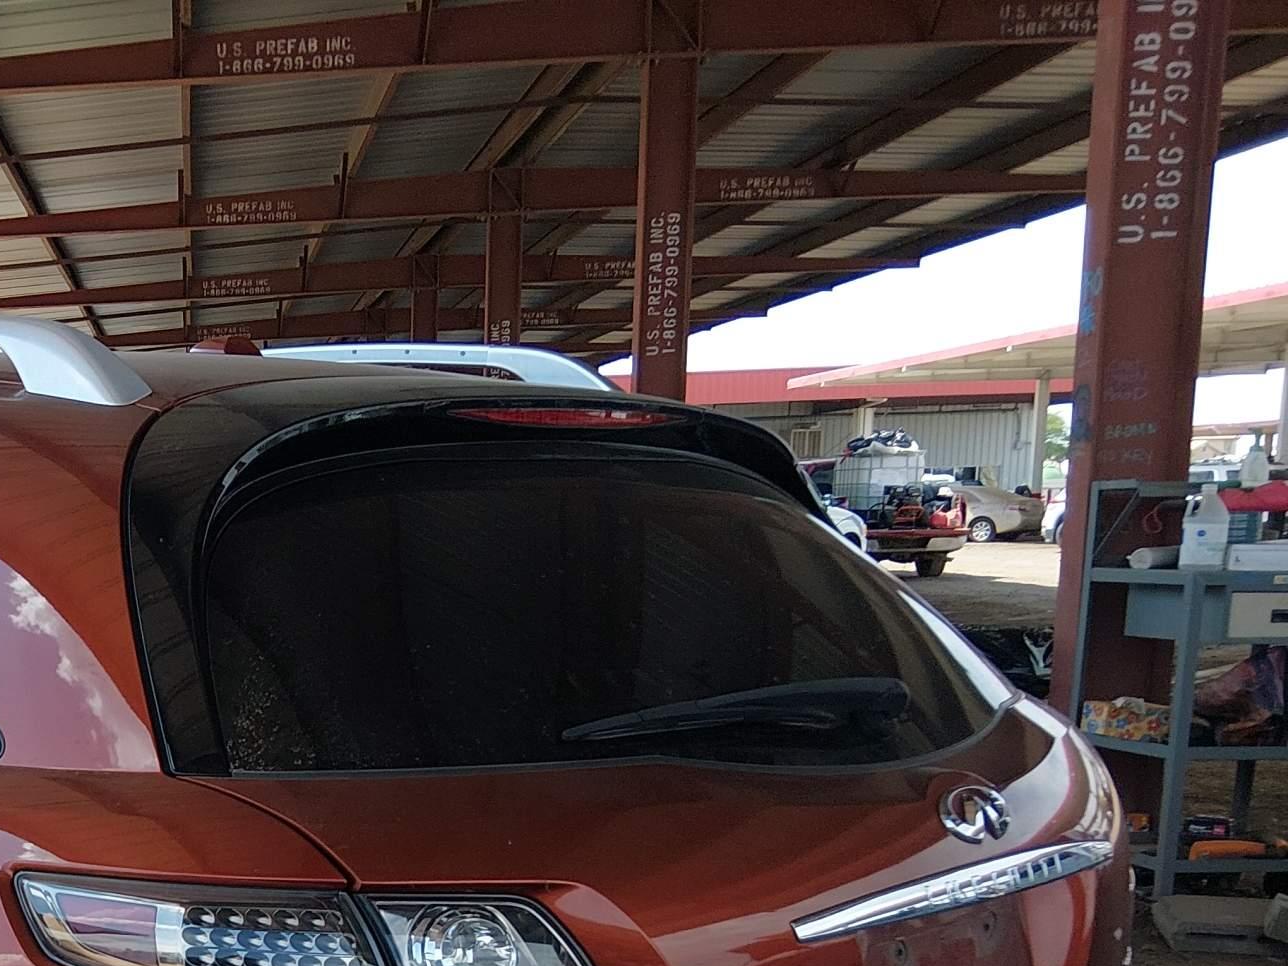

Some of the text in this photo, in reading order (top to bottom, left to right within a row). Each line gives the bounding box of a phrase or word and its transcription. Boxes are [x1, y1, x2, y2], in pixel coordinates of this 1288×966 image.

[216, 42, 247, 58] U.S.
[255, 36, 318, 56] PREFAB
[218, 53, 356, 75] 1-866-799-0969
[1125, 32, 1162, 161] PREFAB
[231, 201, 273, 213] PREFAB
[1117, 182, 1149, 243] U.S.
[645, 212, 665, 356] U.S. PREFAB INC.
[662, 212, 681, 354] 1-866-799-0969
